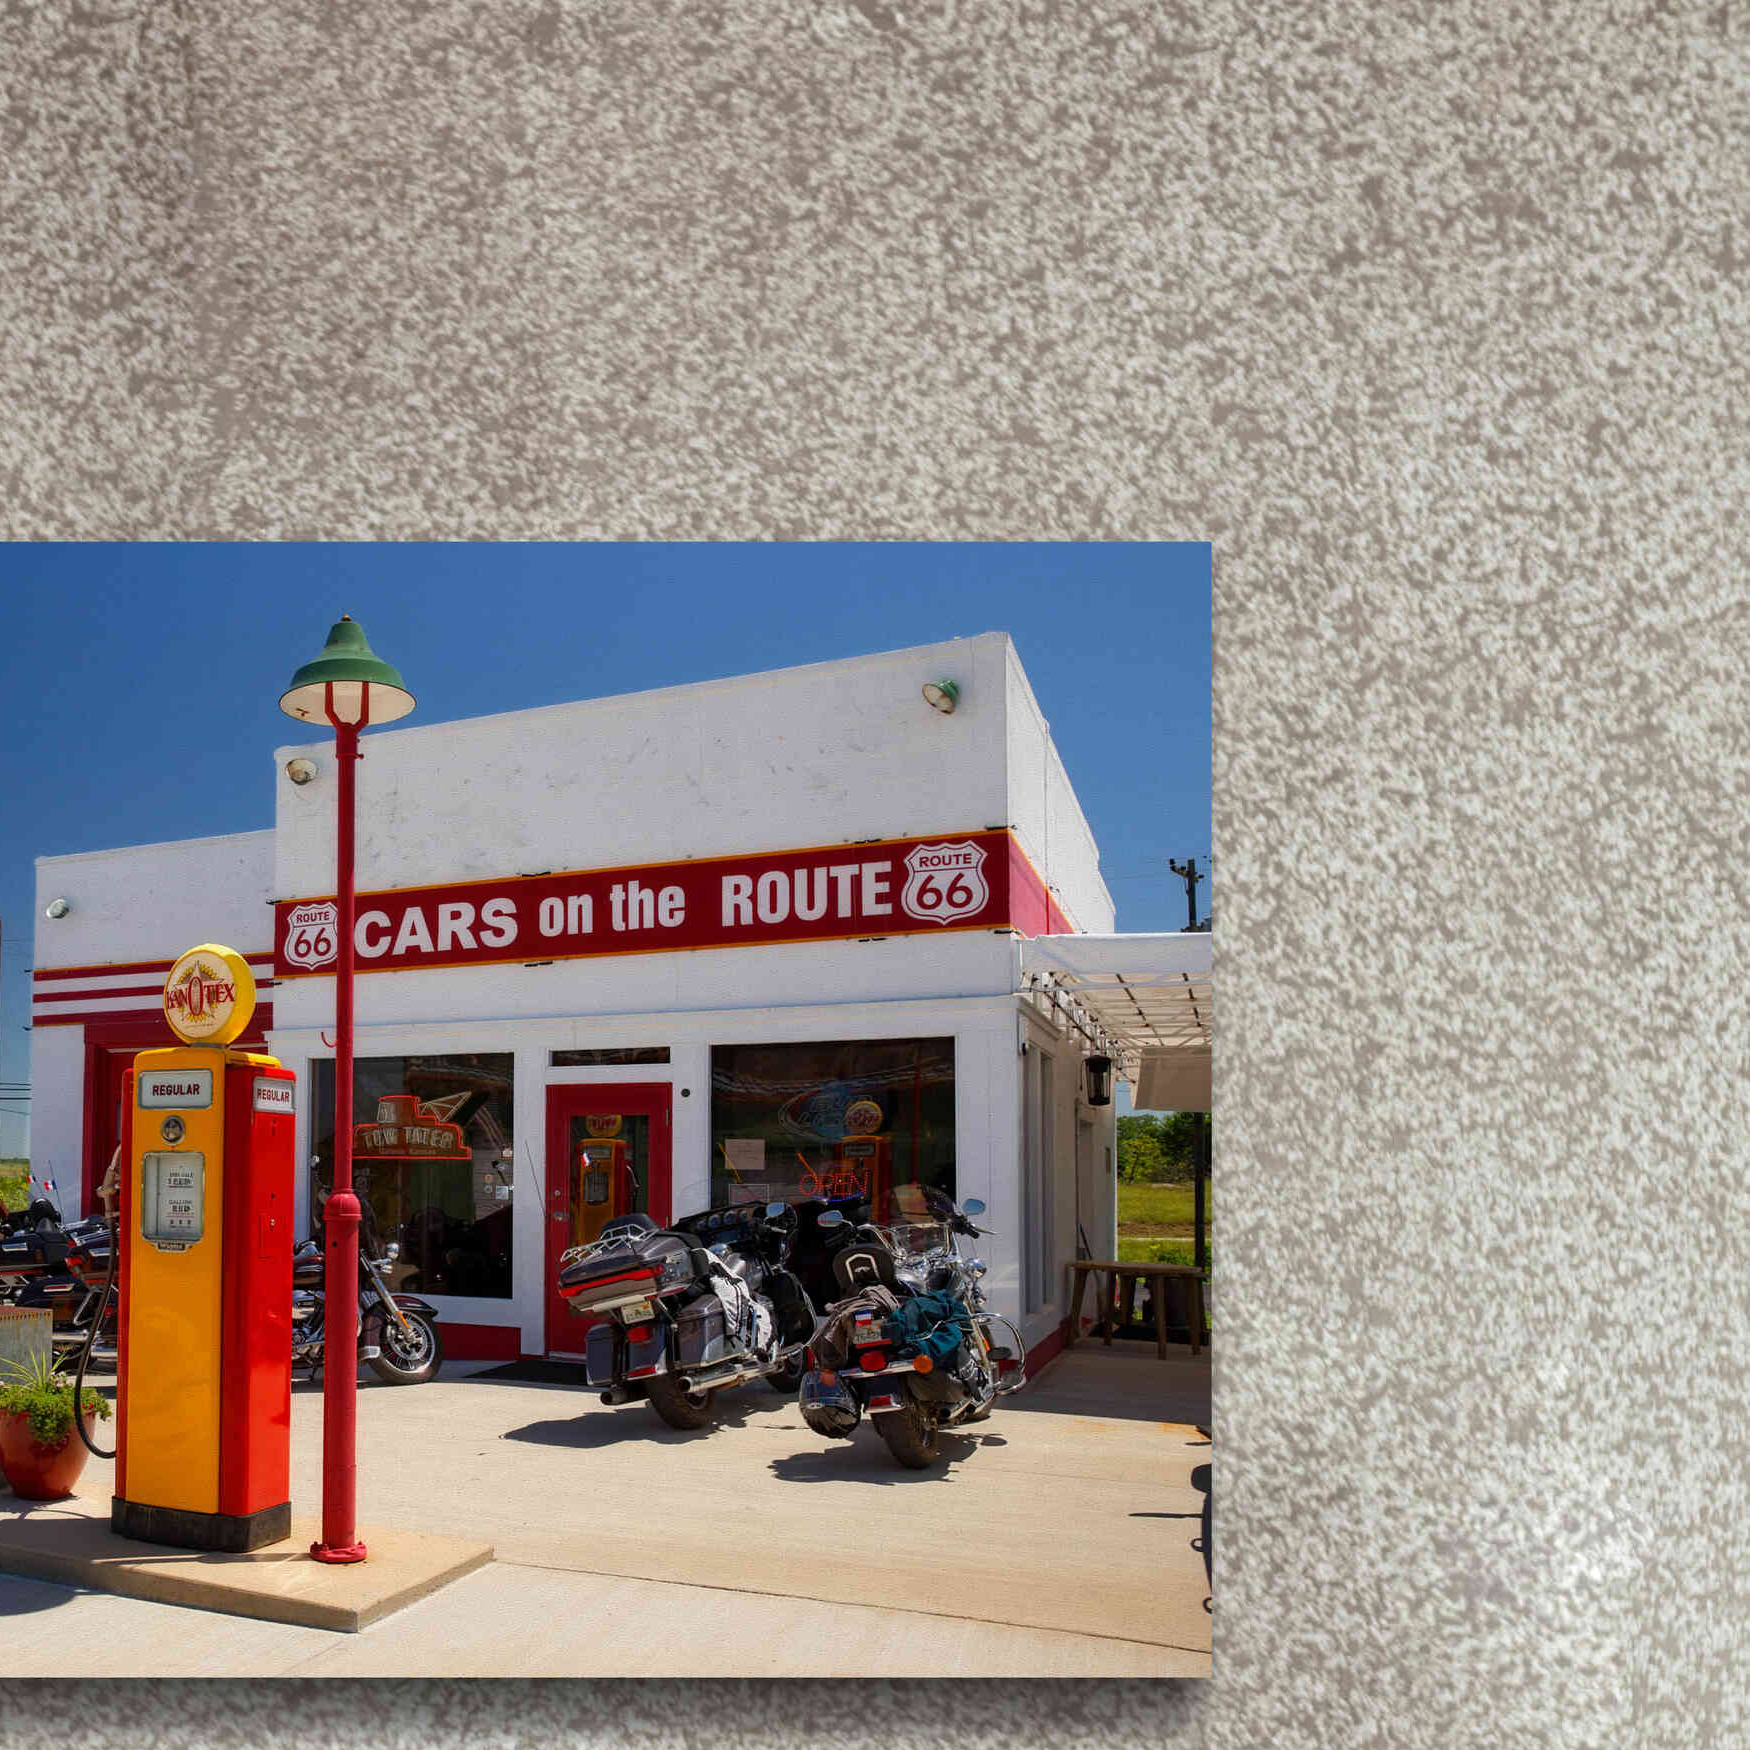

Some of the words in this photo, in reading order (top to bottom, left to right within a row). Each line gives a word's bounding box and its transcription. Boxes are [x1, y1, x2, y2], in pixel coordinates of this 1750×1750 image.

[919, 853, 972, 868] ROUTE
[916, 872, 973, 910] 66
[296, 911, 330, 923] ROUTE
[354, 897, 518, 959] CARS
[539, 893, 593, 937] on
[609, 880, 686, 932] the
[721, 860, 893, 927] ROUTE
[294, 927, 332, 959] 66
[152, 1083, 200, 1097] REGULAR
[257, 1087, 290, 1103] REGULAR
[799, 1171, 869, 1197] OPEN
